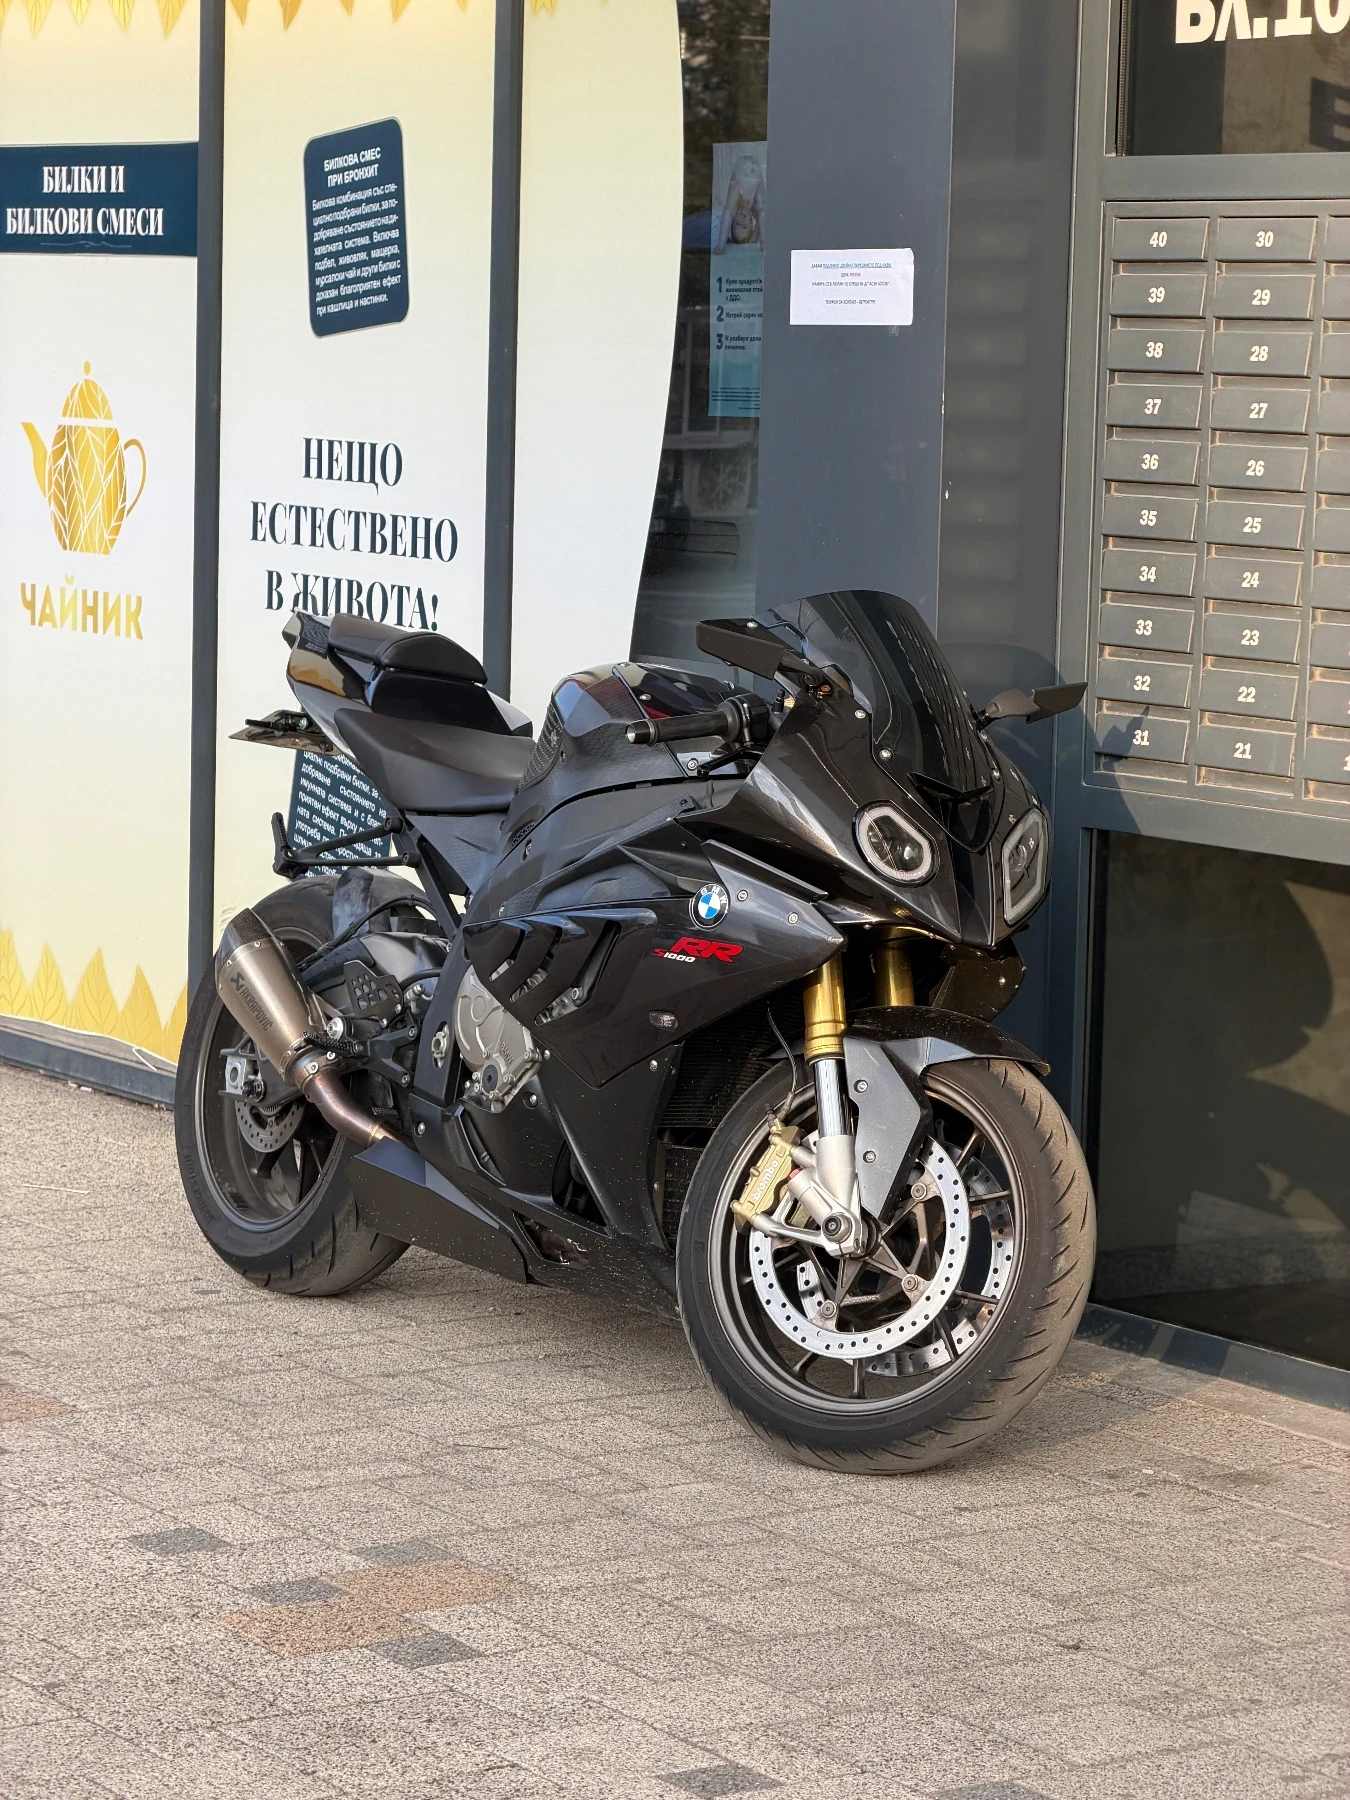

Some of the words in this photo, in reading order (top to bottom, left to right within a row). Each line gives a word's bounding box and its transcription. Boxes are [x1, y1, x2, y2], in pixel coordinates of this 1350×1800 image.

[323, 152, 359, 172] БИЛКОВА
[360, 147, 381, 163] СМЕС
[42, 165, 107, 193] БИЛКИ
[110, 165, 125, 193] И
[327, 172, 343, 188] ПРИ
[344, 163, 379, 184] БРОНХИТ
[312, 197, 336, 211] Билкова
[336, 189, 372, 205] комбинация
[372, 185, 384, 196] със
[384, 183, 398, 194] спе-
[6, 207, 94, 236] БИЛКОВИ
[96, 207, 164, 236] СМЕСИ
[312, 213, 333, 227] циално
[332, 206, 362, 221] подбрани
[361, 202, 381, 215] билки,
[381, 201, 389, 210] за
[388, 198, 398, 208] по-
[313, 226, 344, 243] добряване
[344, 218, 382, 234] състоянието
[1149, 231, 1168, 248] 40
[1255, 230, 1274, 248] 30
[313, 241, 343, 256] хателната
[344, 235, 371, 249] система.
[373, 228, 400, 243] Включва
[314, 257, 336, 271] подбел,
[338, 251, 369, 265] живовляк,
[371, 244, 400, 258] мащерка,
[315, 272, 346, 288] мурсалски
[345, 267, 357, 279] чай
[356, 270, 361, 278] и
[360, 264, 378, 278] други
[378, 260, 396, 273] билки
[396, 259, 401, 268] с
[315, 288, 339, 303] доказан
[339, 278, 381, 295] благоприятен
[382, 274, 402, 288] ефект
[716, 276, 723, 294] 1
[1147, 286, 1166, 304] 39
[316, 305, 327, 317] при
[327, 299, 354, 313] кашлица
[354, 299, 359, 307] и
[359, 293, 389, 307] настинки.
[1251, 288, 1271, 306] 29
[716, 305, 725, 322] 2
[716, 333, 724, 350] 3
[1145, 341, 1164, 359] 38
[1249, 345, 1269, 362] 28
[1144, 398, 1162, 415] 37
[1248, 402, 1269, 419] 27
[302, 437, 403, 495] НЕЩО
[1141, 453, 1160, 470] 36
[1245, 459, 1265, 477] 26
[1139, 509, 1158, 527] 35
[1242, 516, 1262, 534] 25
[250, 500, 459, 563] ЕСТЕСТВЕНО
[1138, 565, 1157, 583] 34
[1241, 571, 1260, 588] 24
[20, 574, 144, 640] ЧАЙНИК
[264, 569, 284, 610] В
[290, 572, 439, 632] ЖИВОТА!
[1135, 619, 1153, 636] 33
[1240, 629, 1260, 646] 23
[1133, 675, 1151, 692] 32
[1237, 685, 1256, 703] 22
[1132, 729, 1150, 746] 31
[1233, 742, 1252, 760] 21
[323, 760, 352, 783] подбрани
[351, 774, 371, 796] билки,
[371, 788, 379, 799] за
[300, 777, 326, 799] имунната
[327, 794, 352, 814] система
[354, 808, 359, 818] и
[360, 812, 365, 822] с
[301, 763, 331, 787] добряване
[339, 785, 376, 812] състоянието
[378, 808, 387, 819] на
[296, 805, 310, 819] ната
[312, 814, 336, 836] система.
[298, 791, 322, 812] приятен
[321, 805, 340, 822] ефект
[340, 816, 358, 834] върху
[295, 819, 321, 842] употреба
[652, 948, 696, 963] S1000
[670, 936, 744, 964] RR
[751, 1160, 779, 1201] brembo
